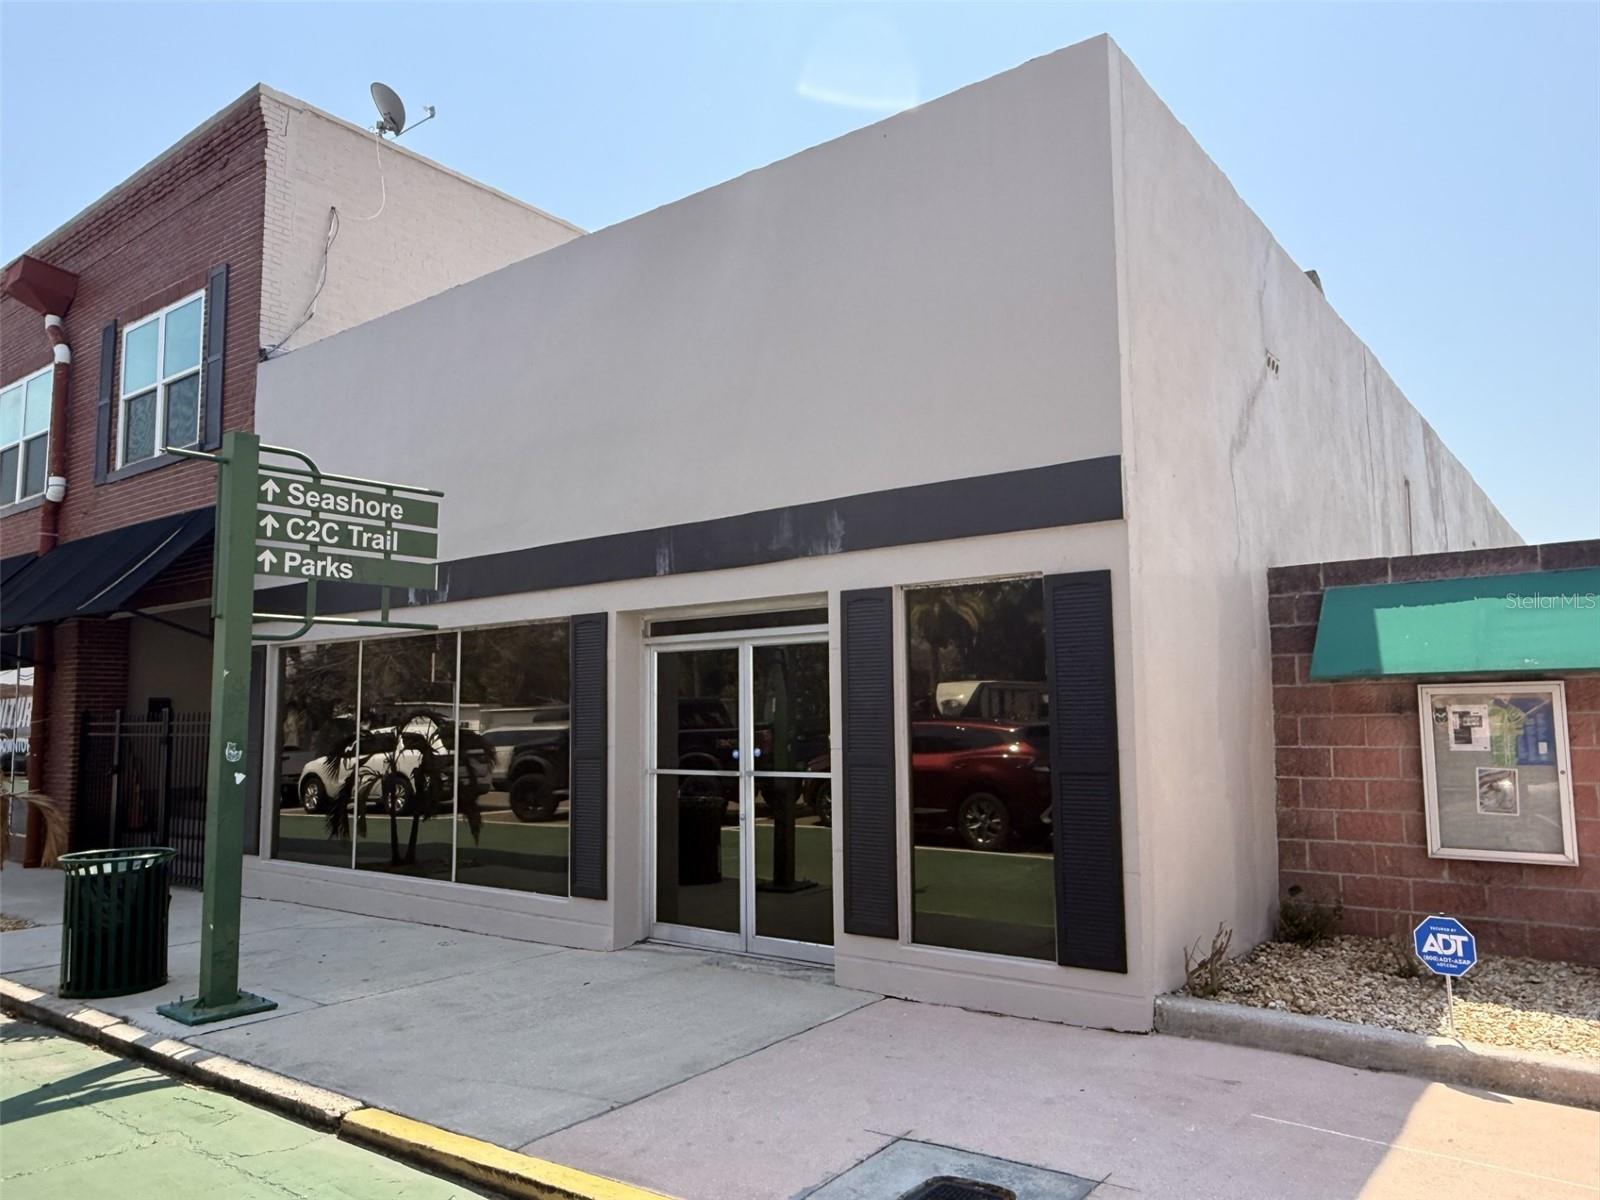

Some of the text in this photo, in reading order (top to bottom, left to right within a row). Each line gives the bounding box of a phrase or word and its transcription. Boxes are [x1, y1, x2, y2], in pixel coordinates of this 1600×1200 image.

[287, 483, 404, 520] Seashore
[286, 518, 399, 551] C2C Trail
[284, 552, 353, 579] Parks
[1422, 933, 1469, 957] ADT
